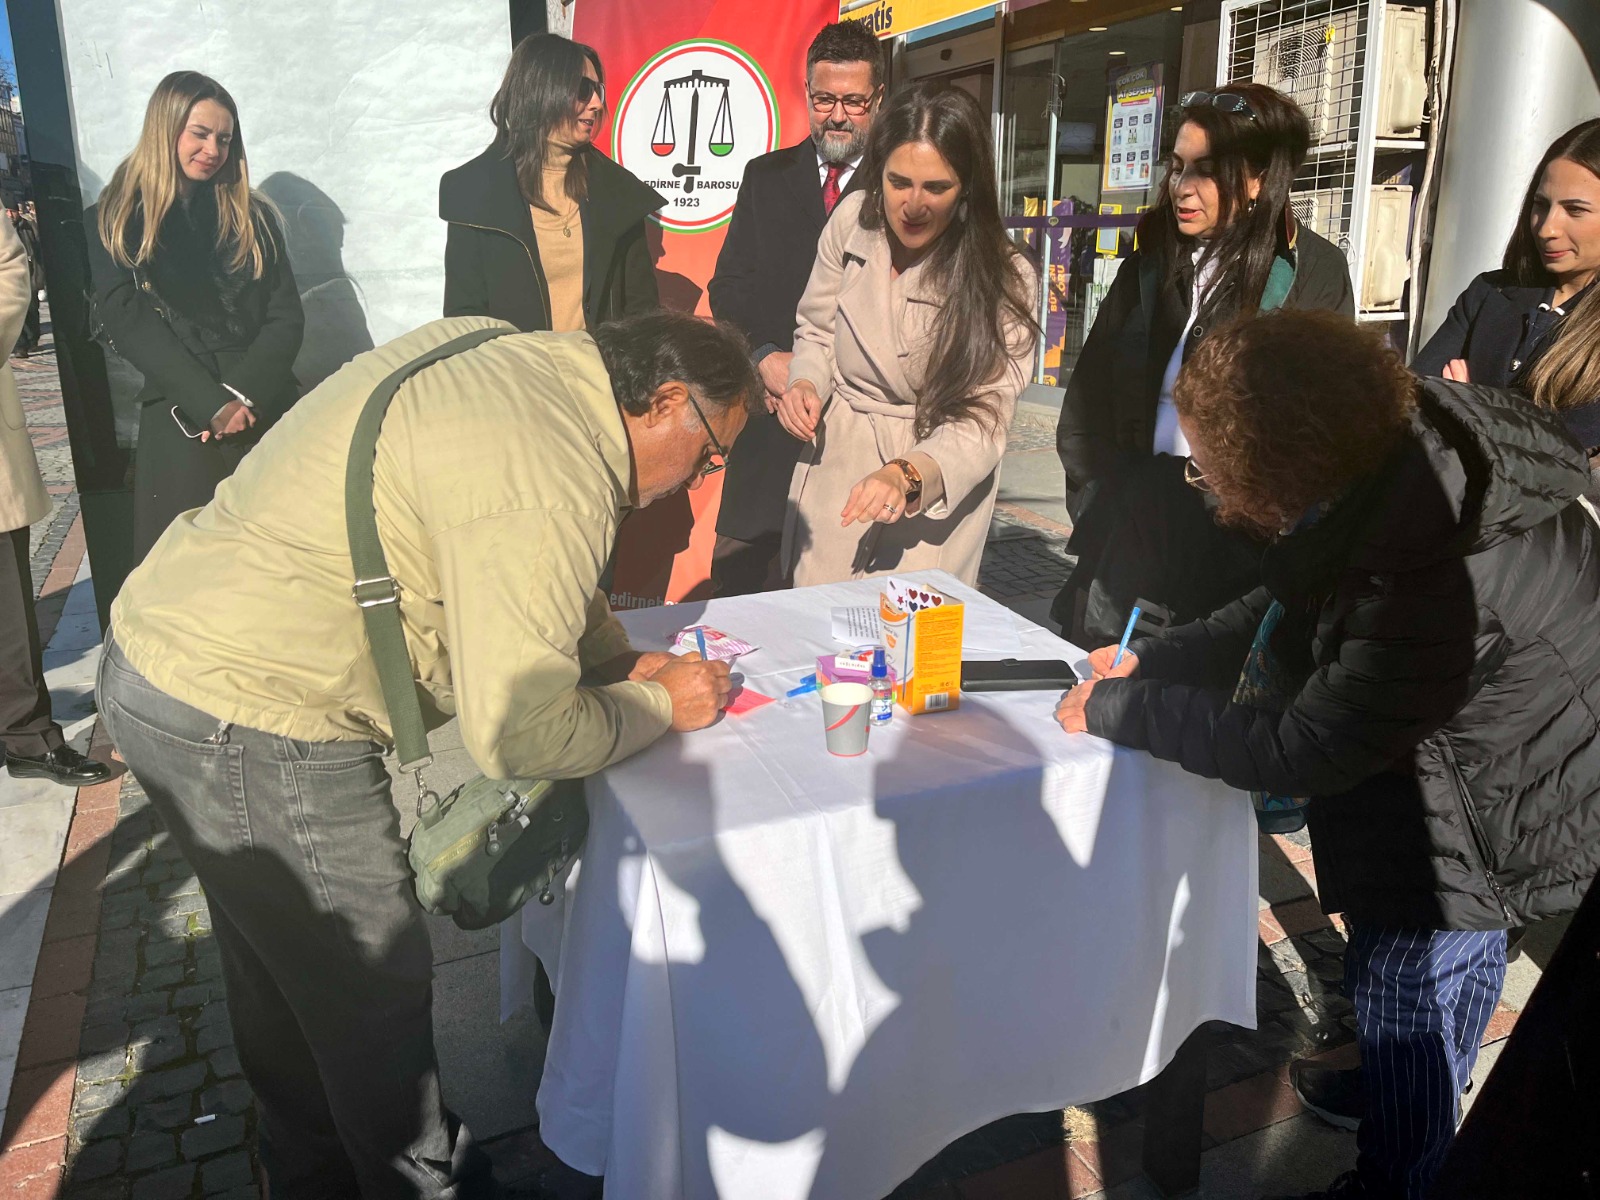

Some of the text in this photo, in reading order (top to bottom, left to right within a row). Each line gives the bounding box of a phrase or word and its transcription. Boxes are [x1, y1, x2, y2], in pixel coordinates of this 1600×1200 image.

[861, 1, 893, 32] ratis
[696, 180, 740, 190] BAROSU
[673, 197, 700, 207] 1923
[610, 592, 679, 608] edirneb
